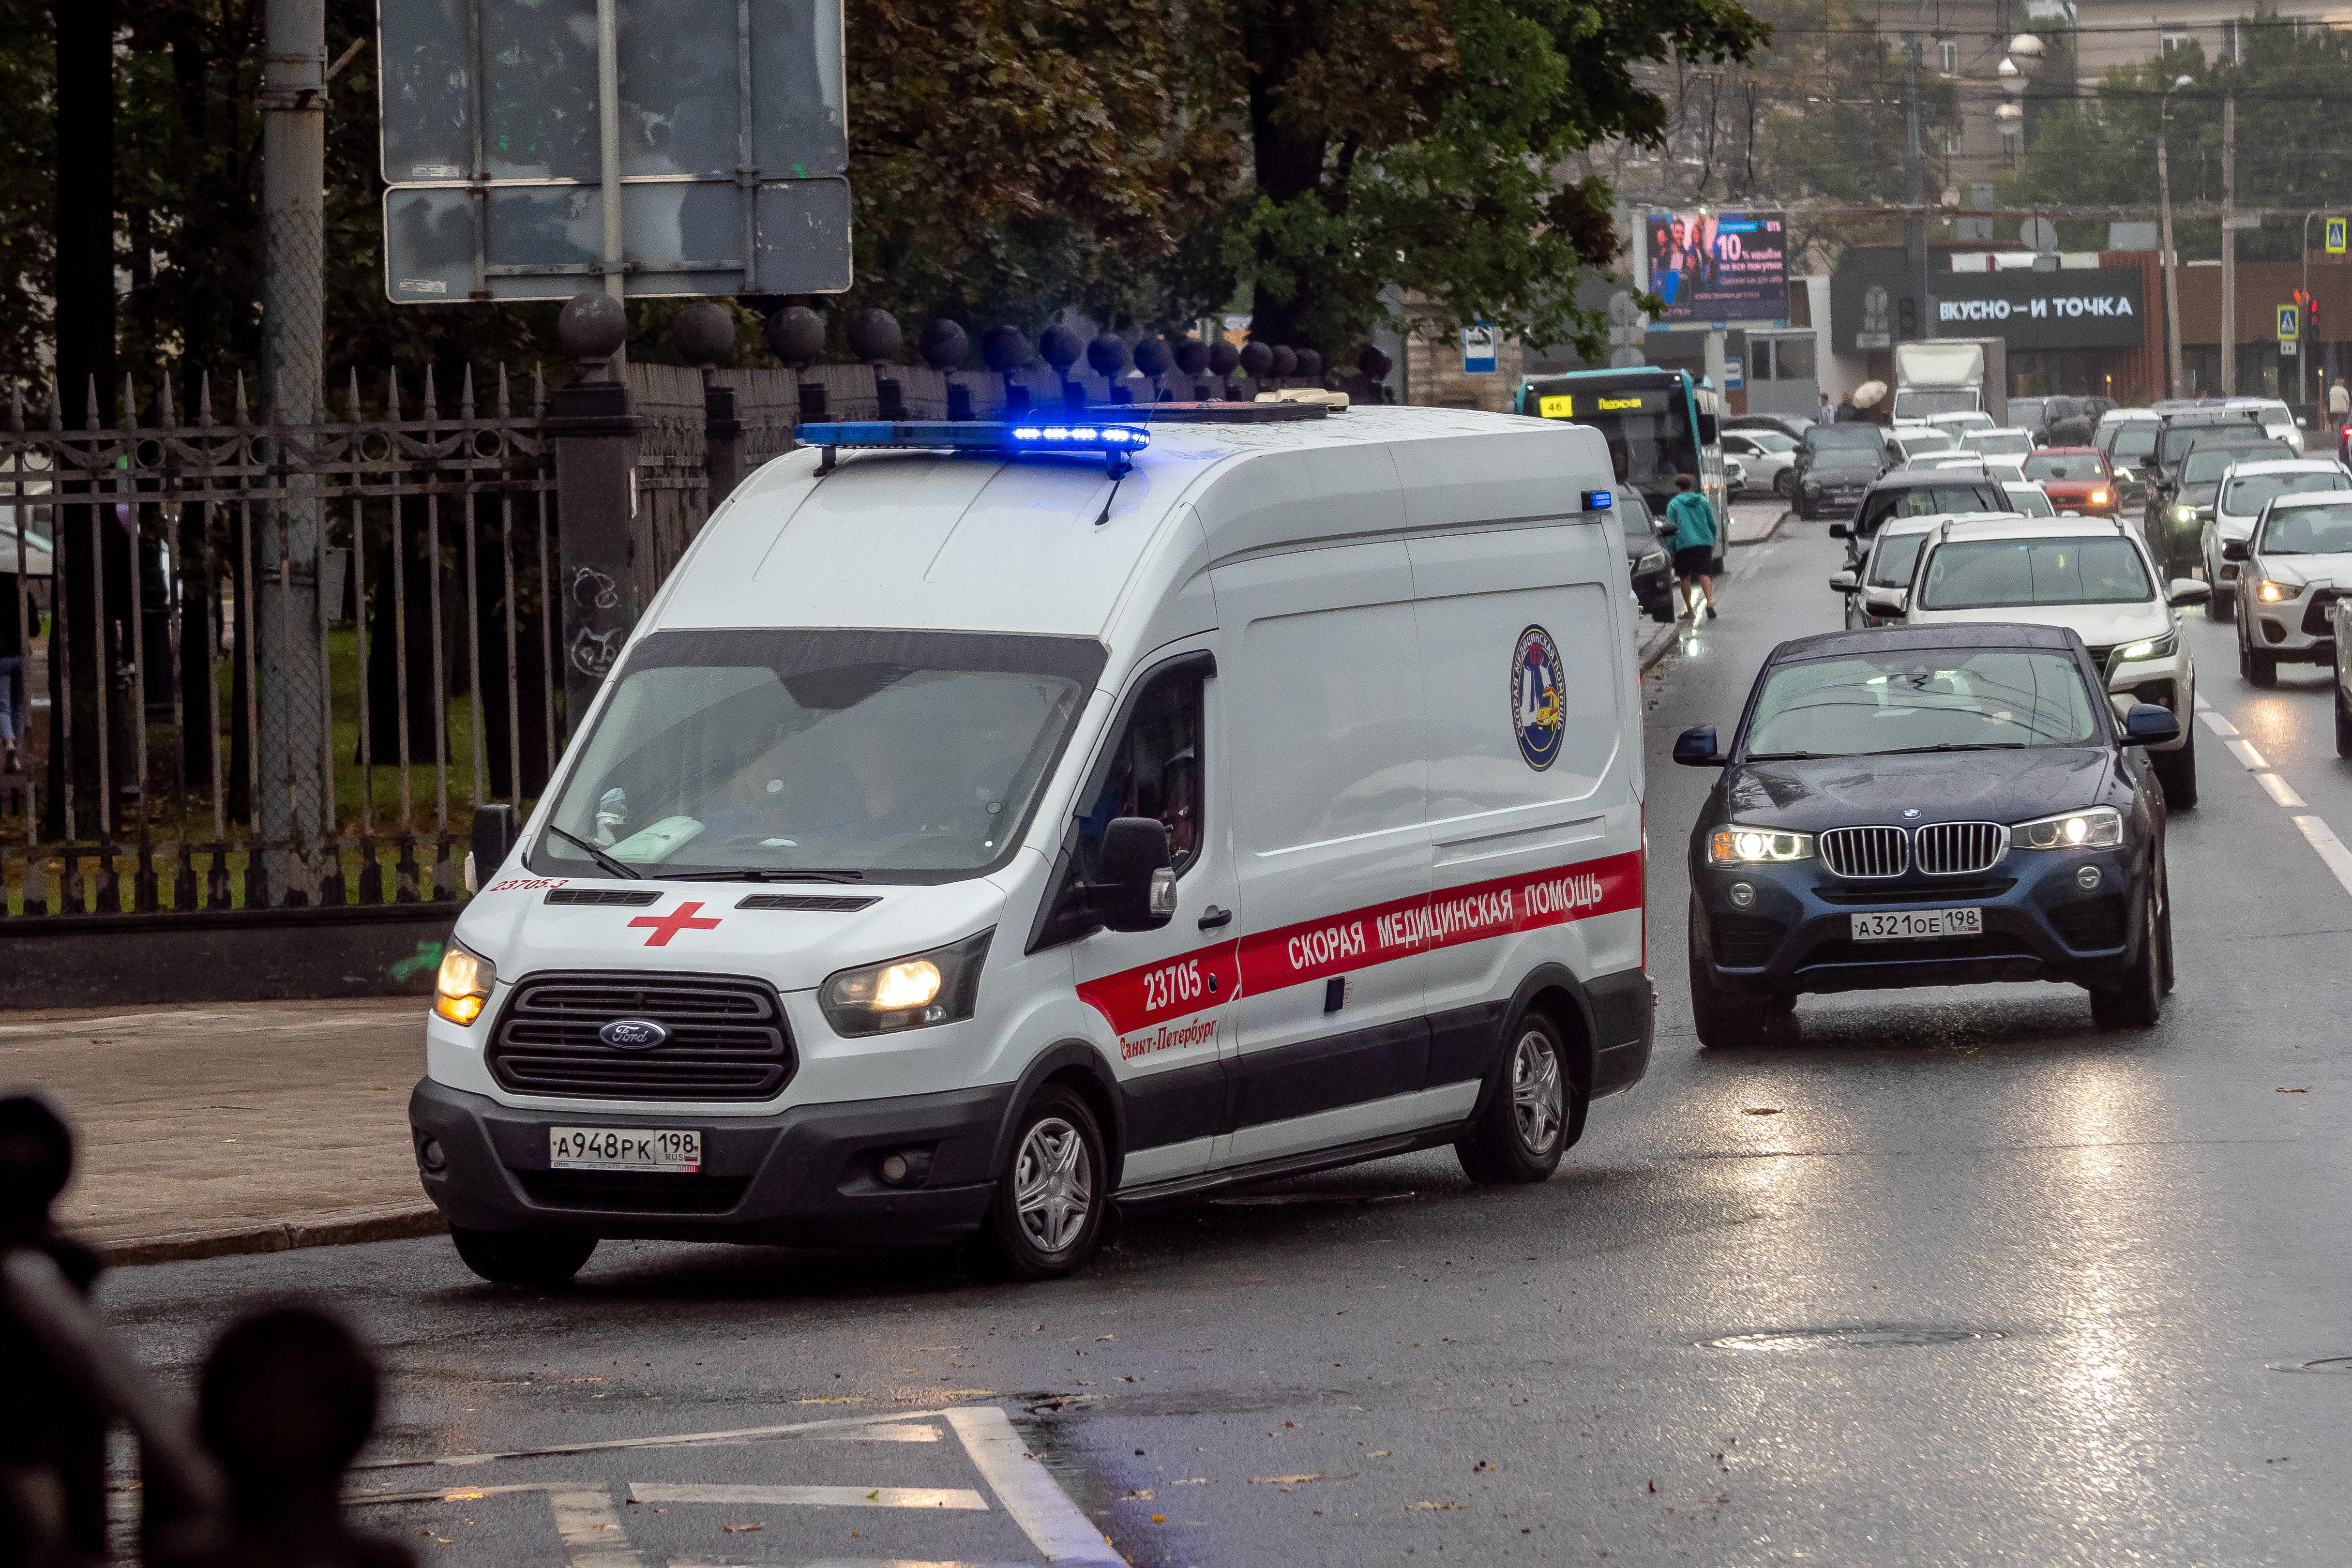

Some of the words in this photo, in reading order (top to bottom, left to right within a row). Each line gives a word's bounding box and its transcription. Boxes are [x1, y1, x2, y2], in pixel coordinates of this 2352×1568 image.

[1766, 221, 1781, 232] ВТБ
[1717, 234, 1742, 260] 10
[1719, 263, 1730, 271] на
[1731, 262, 1746, 272] все
[1746, 261, 1783, 272] покупки
[1940, 299, 2011, 321] ВКУСНО
[2031, 298, 2047, 318] И
[2052, 296, 2133, 317] ТОЧКА
[1548, 402, 1562, 412] 46
[1515, 632, 1555, 673] МЕДИЦИНСКАЯ
[1529, 642, 1542, 664] 03
[1513, 677, 1523, 737] СКОРАЯ
[1554, 660, 1564, 730] ПОМОЩЬ
[489, 879, 569, 892] 23705.3
[1288, 921, 1365, 969] СКОРАЯ
[1378, 889, 1513, 949] МЕДИЦИНСКАЯ
[1524, 873, 1603, 916] ПОМОЩЬ
[1859, 914, 1940, 936] А321ОЕ
[1945, 910, 1975, 926] 198
[1143, 959, 1202, 1011] 23705
[612, 1025, 648, 1042] Ford
[1119, 1018, 1218, 1061] Санкт-Петербург
[557, 1132, 651, 1160] А948РК
[657, 1133, 694, 1153] 198
